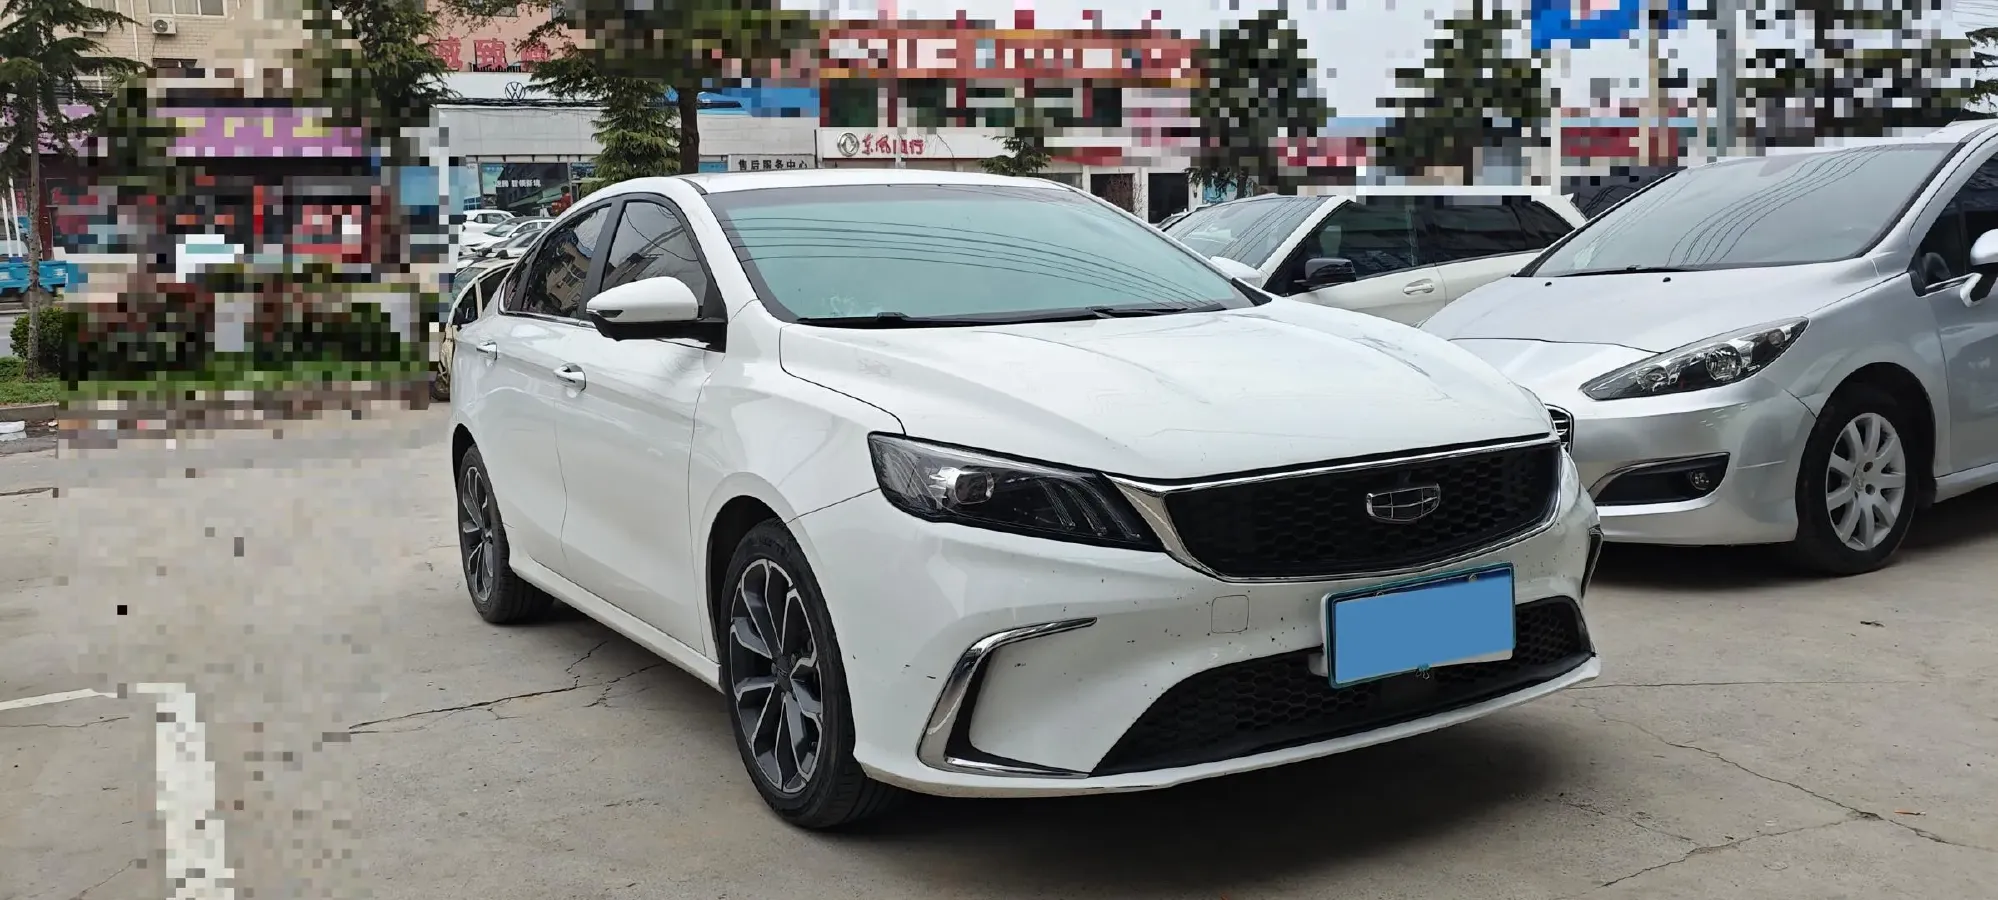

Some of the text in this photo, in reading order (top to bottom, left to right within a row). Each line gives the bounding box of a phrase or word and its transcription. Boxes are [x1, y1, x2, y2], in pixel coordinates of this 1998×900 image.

[738, 158, 808, 171] 售后服务中心
